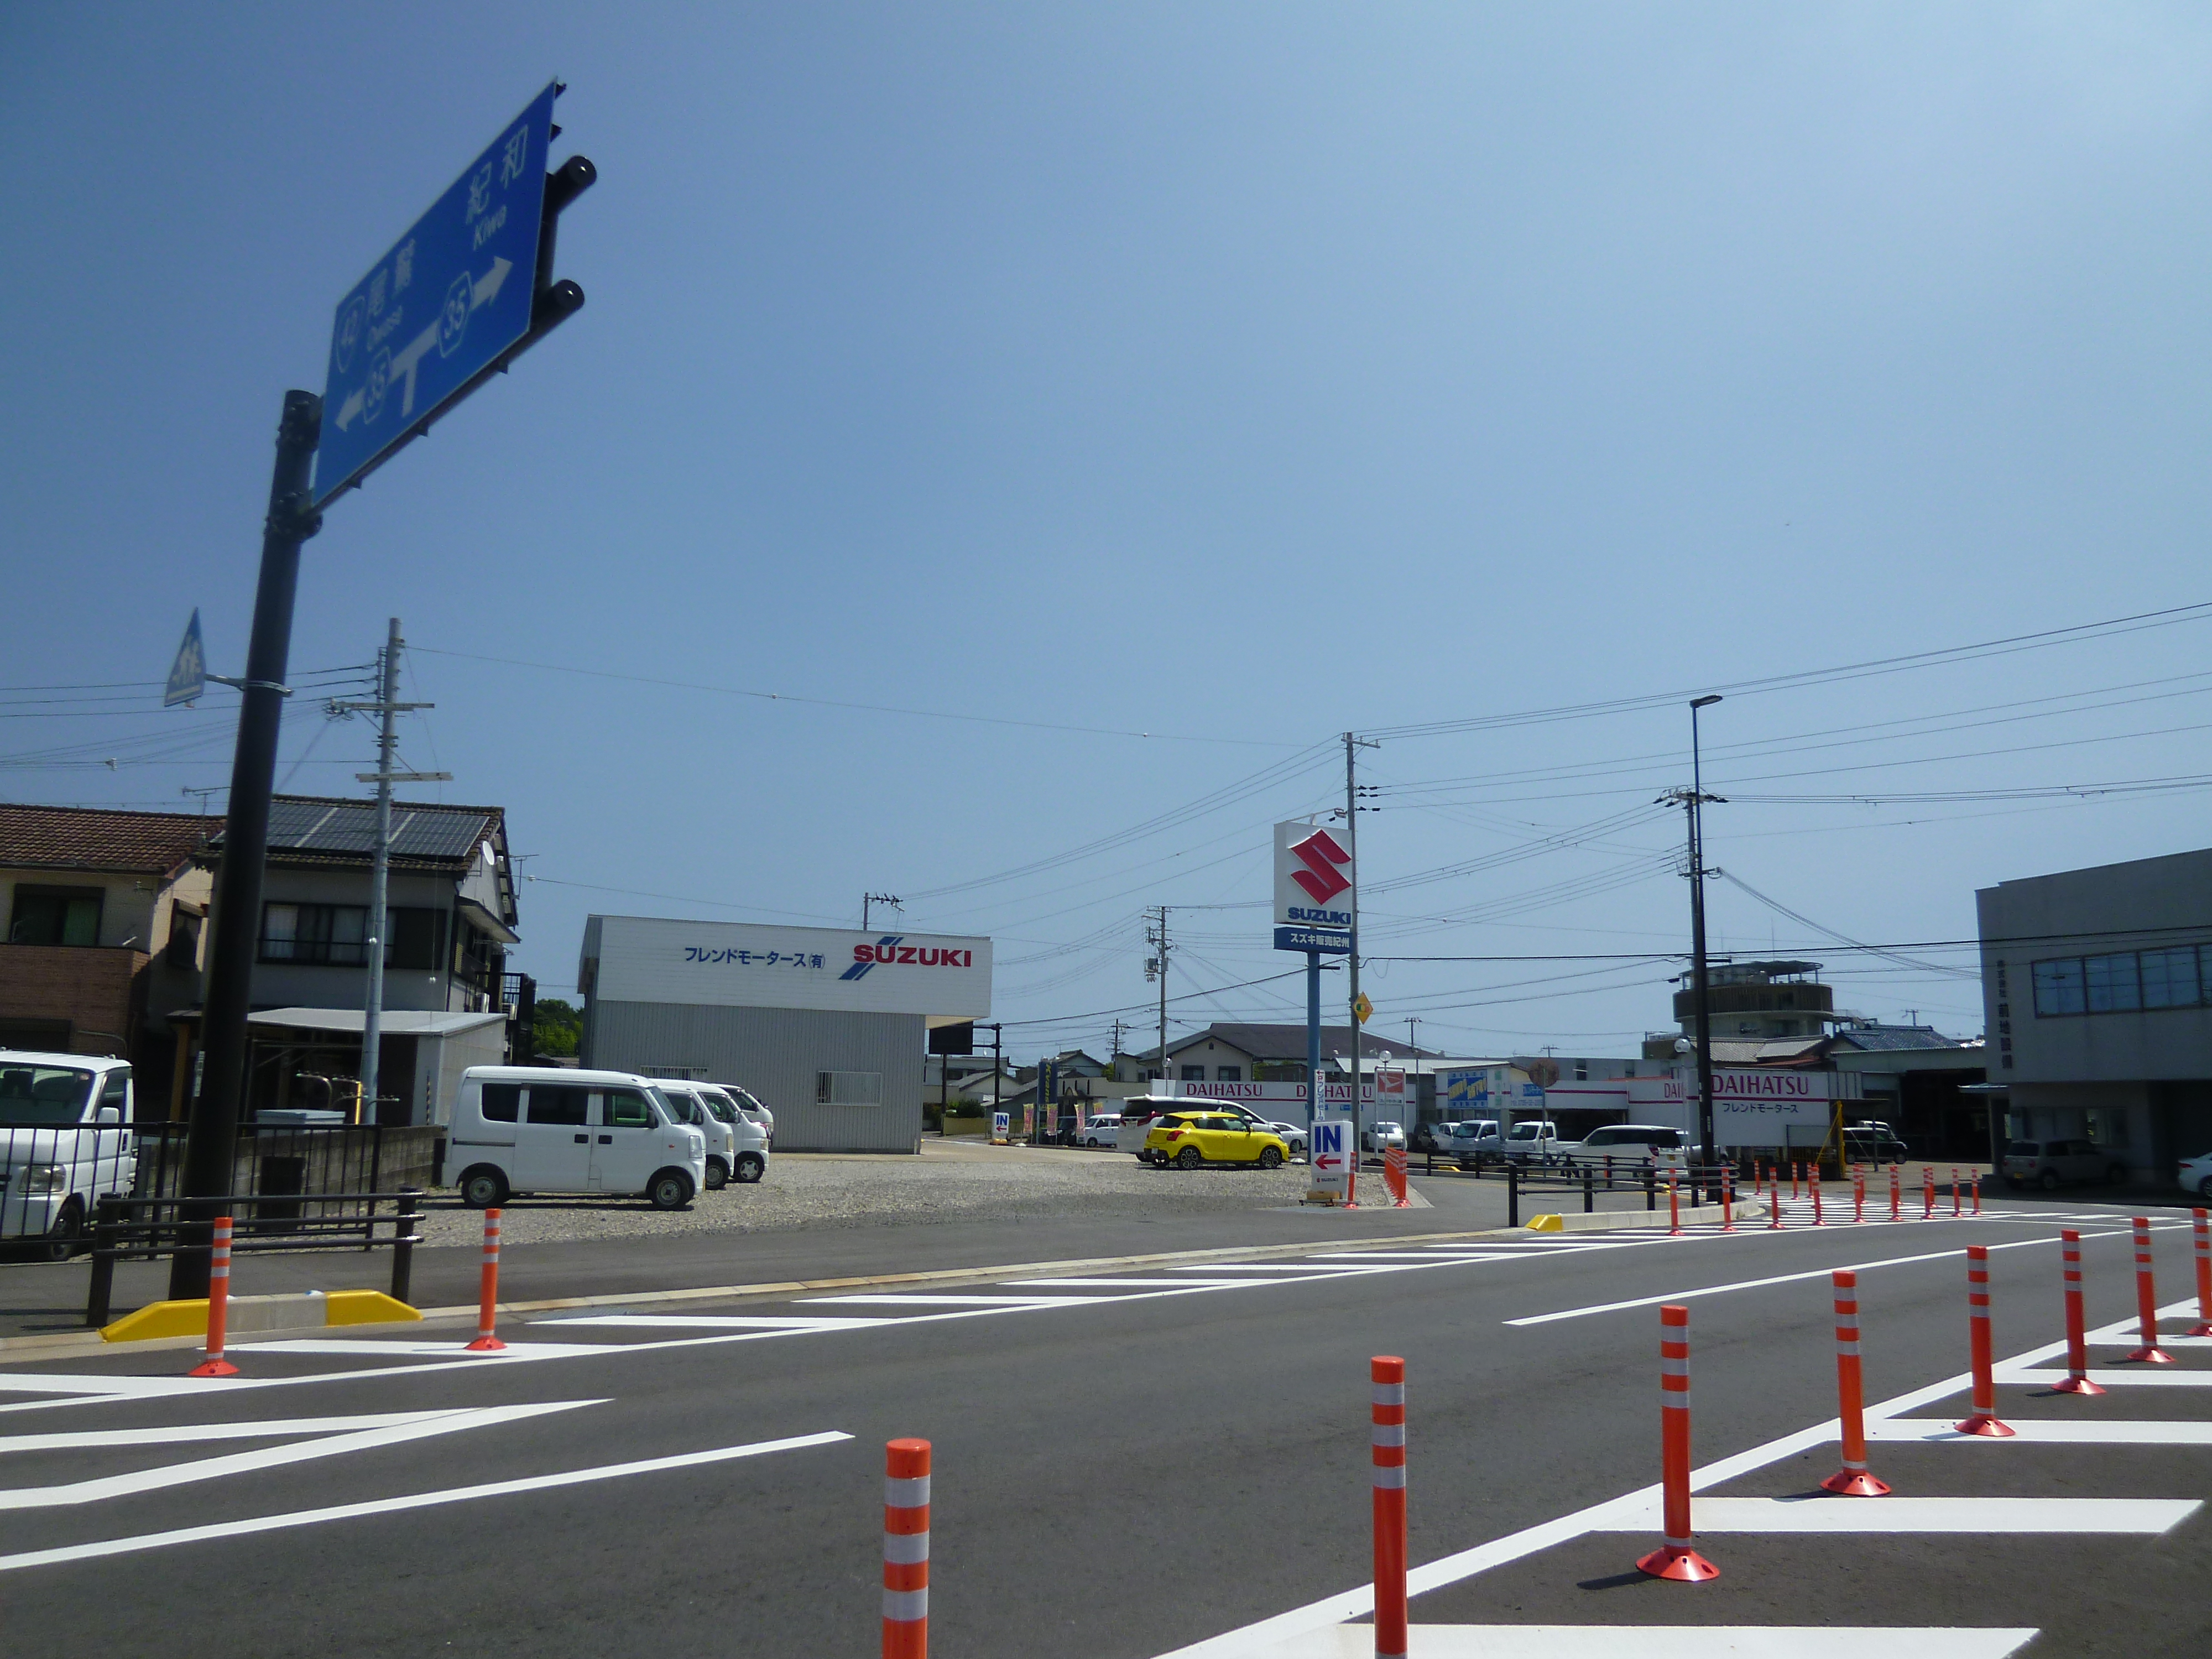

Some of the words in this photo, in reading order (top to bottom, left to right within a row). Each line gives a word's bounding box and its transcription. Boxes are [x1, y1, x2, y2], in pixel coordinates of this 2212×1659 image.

[466, 124, 529, 225] 紀和
[1288, 907, 1351, 925] SUZUKI
[1290, 933, 1350, 948] スズキ販売紀州
[853, 944, 972, 967] SUZUKI
[1186, 1083, 1263, 1097] DAIHATSU
[1711, 1074, 1809, 1095] DAIHATSU
[1722, 1103, 1798, 1113] フレンドモータース
[997, 1115, 1008, 1126] IN
[1314, 1125, 1341, 1153] IN
